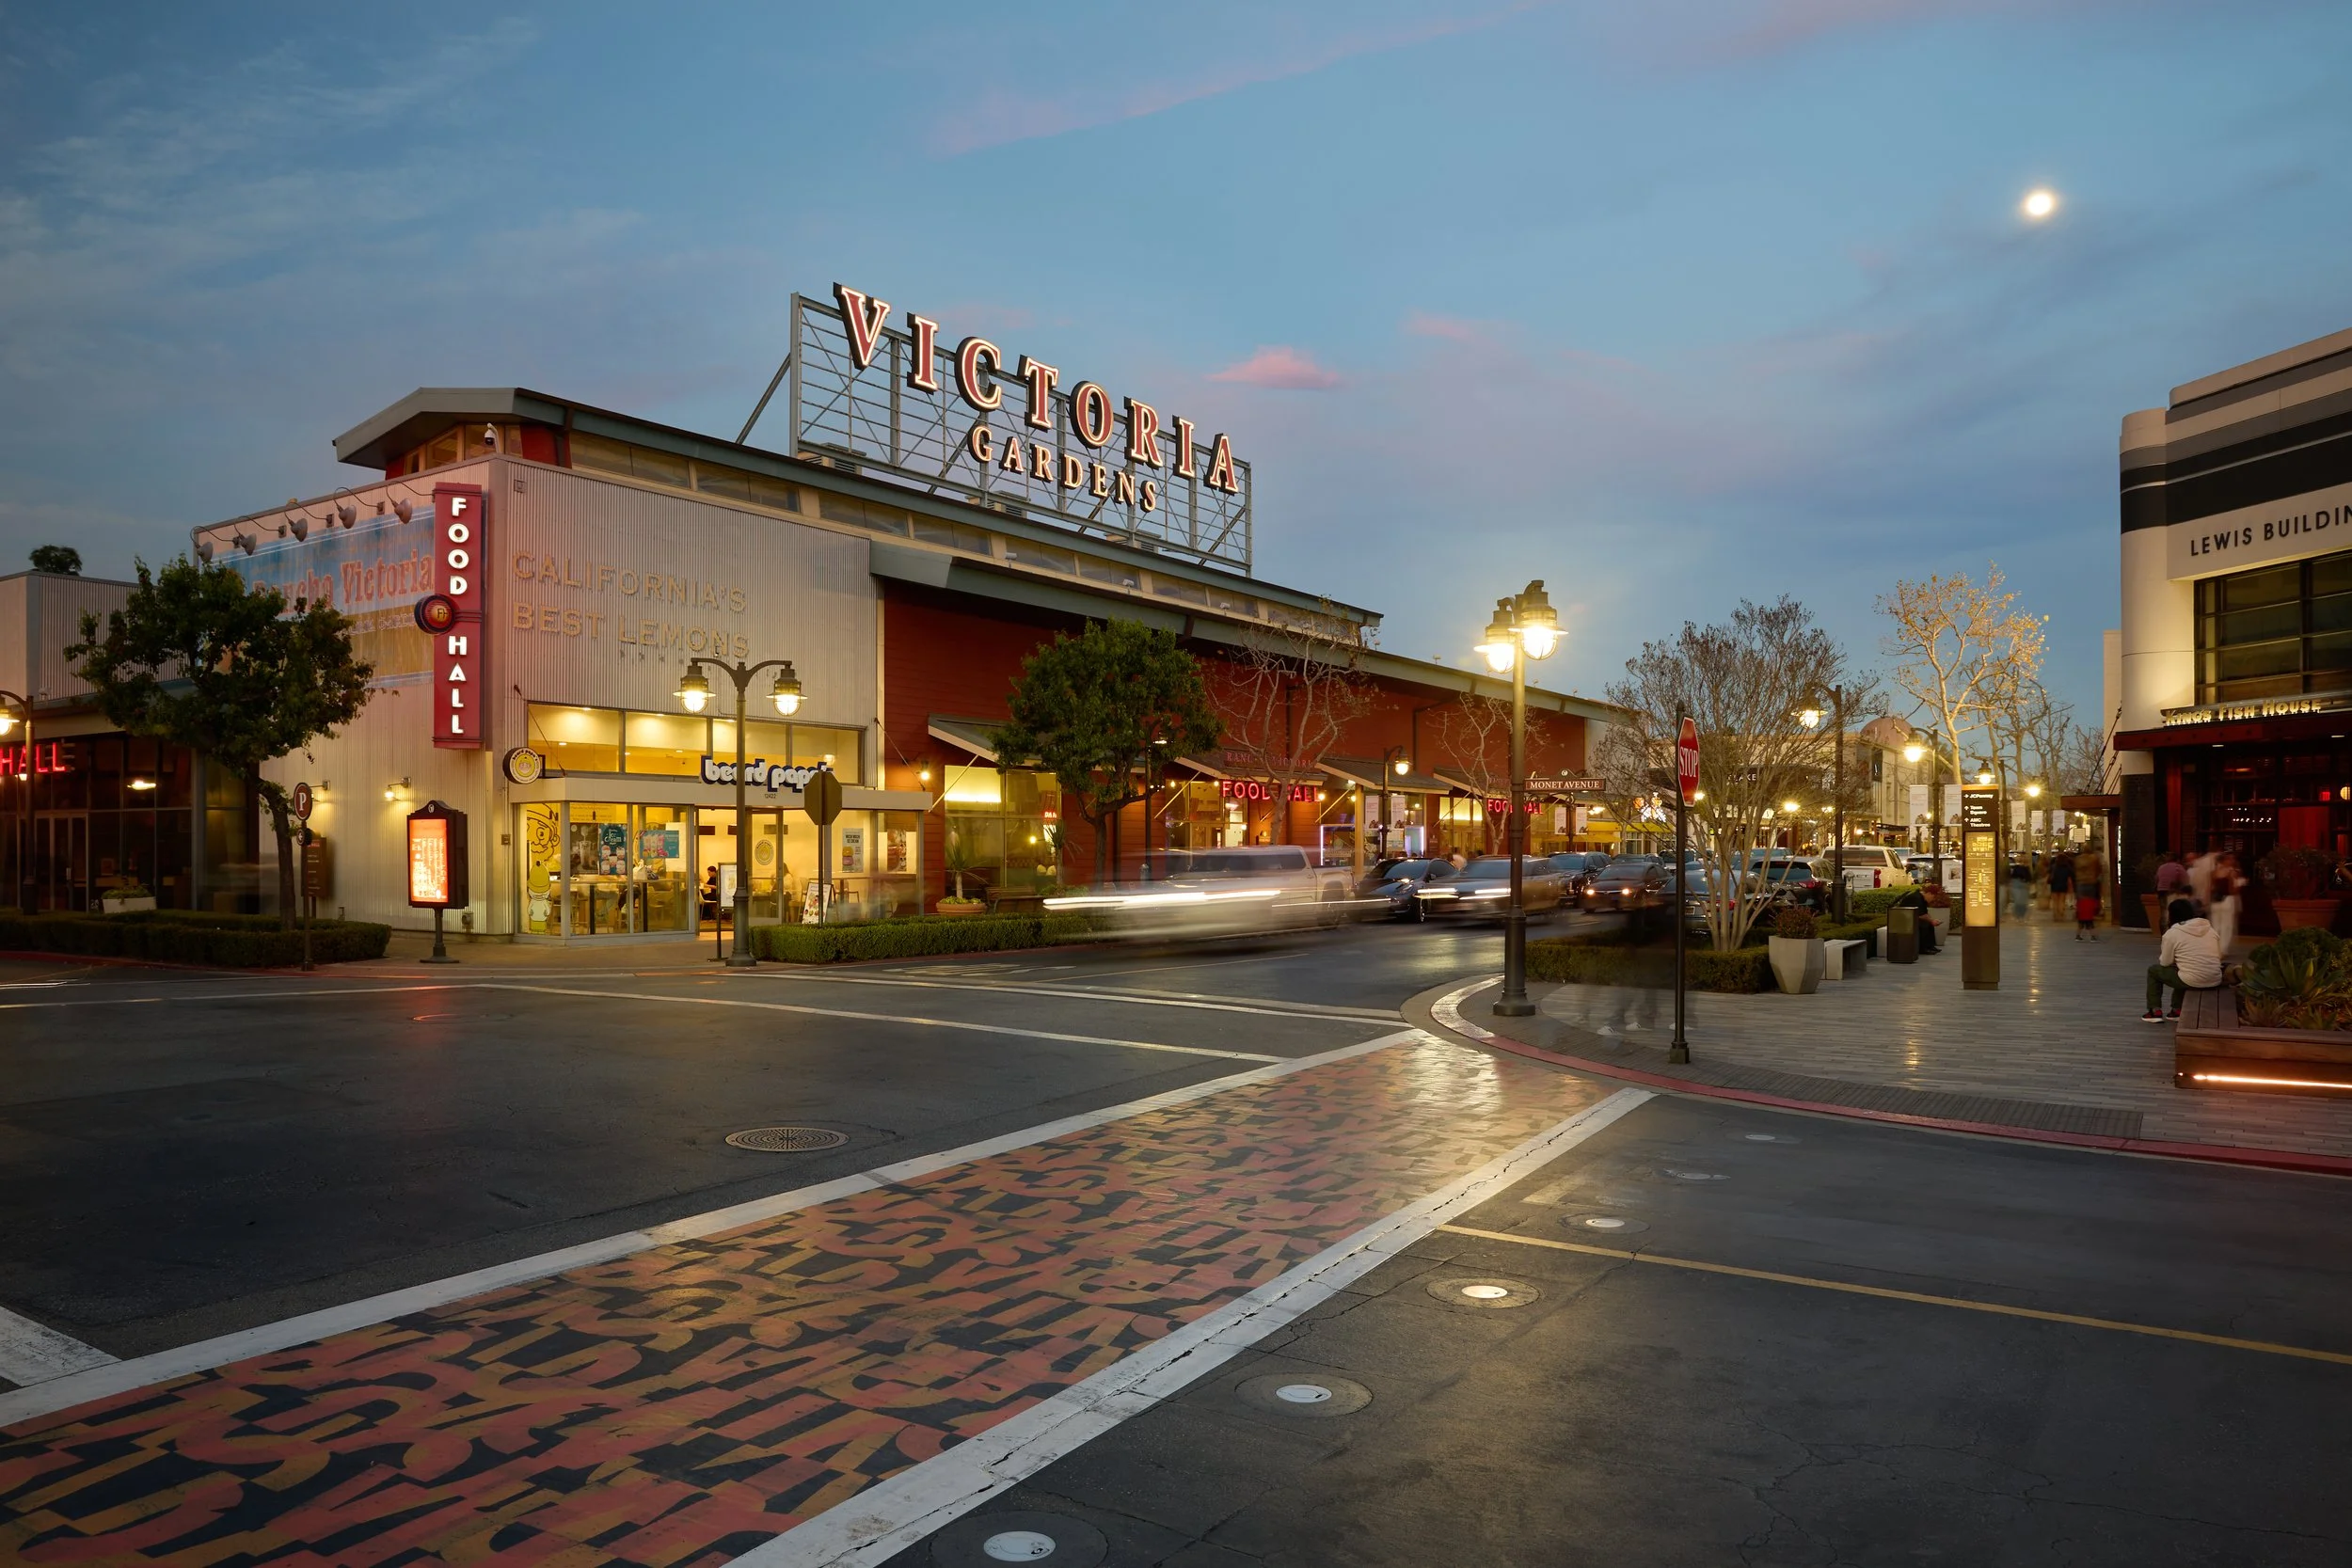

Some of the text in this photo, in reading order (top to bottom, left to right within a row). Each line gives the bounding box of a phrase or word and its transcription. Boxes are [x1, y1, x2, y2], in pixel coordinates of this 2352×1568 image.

[834, 283, 1239, 495] VICTORIA
[969, 426, 1156, 513] GARDENS
[2191, 528, 2252, 556] LEWIS
[340, 549, 435, 604] Victoria
[513, 550, 747, 613] CALIFORNIA'S
[448, 498, 469, 734] FOOD HALL
[513, 602, 750, 658] BEST LEMONS
[2218, 703, 2255, 721] FISH
[2263, 698, 2322, 718] HOUSE
[1679, 747, 1698, 778] STOP
[298, 792, 308, 811] P
[1287, 784, 1321, 802] ALL
[1530, 781, 1600, 789] MONET AVENUE
